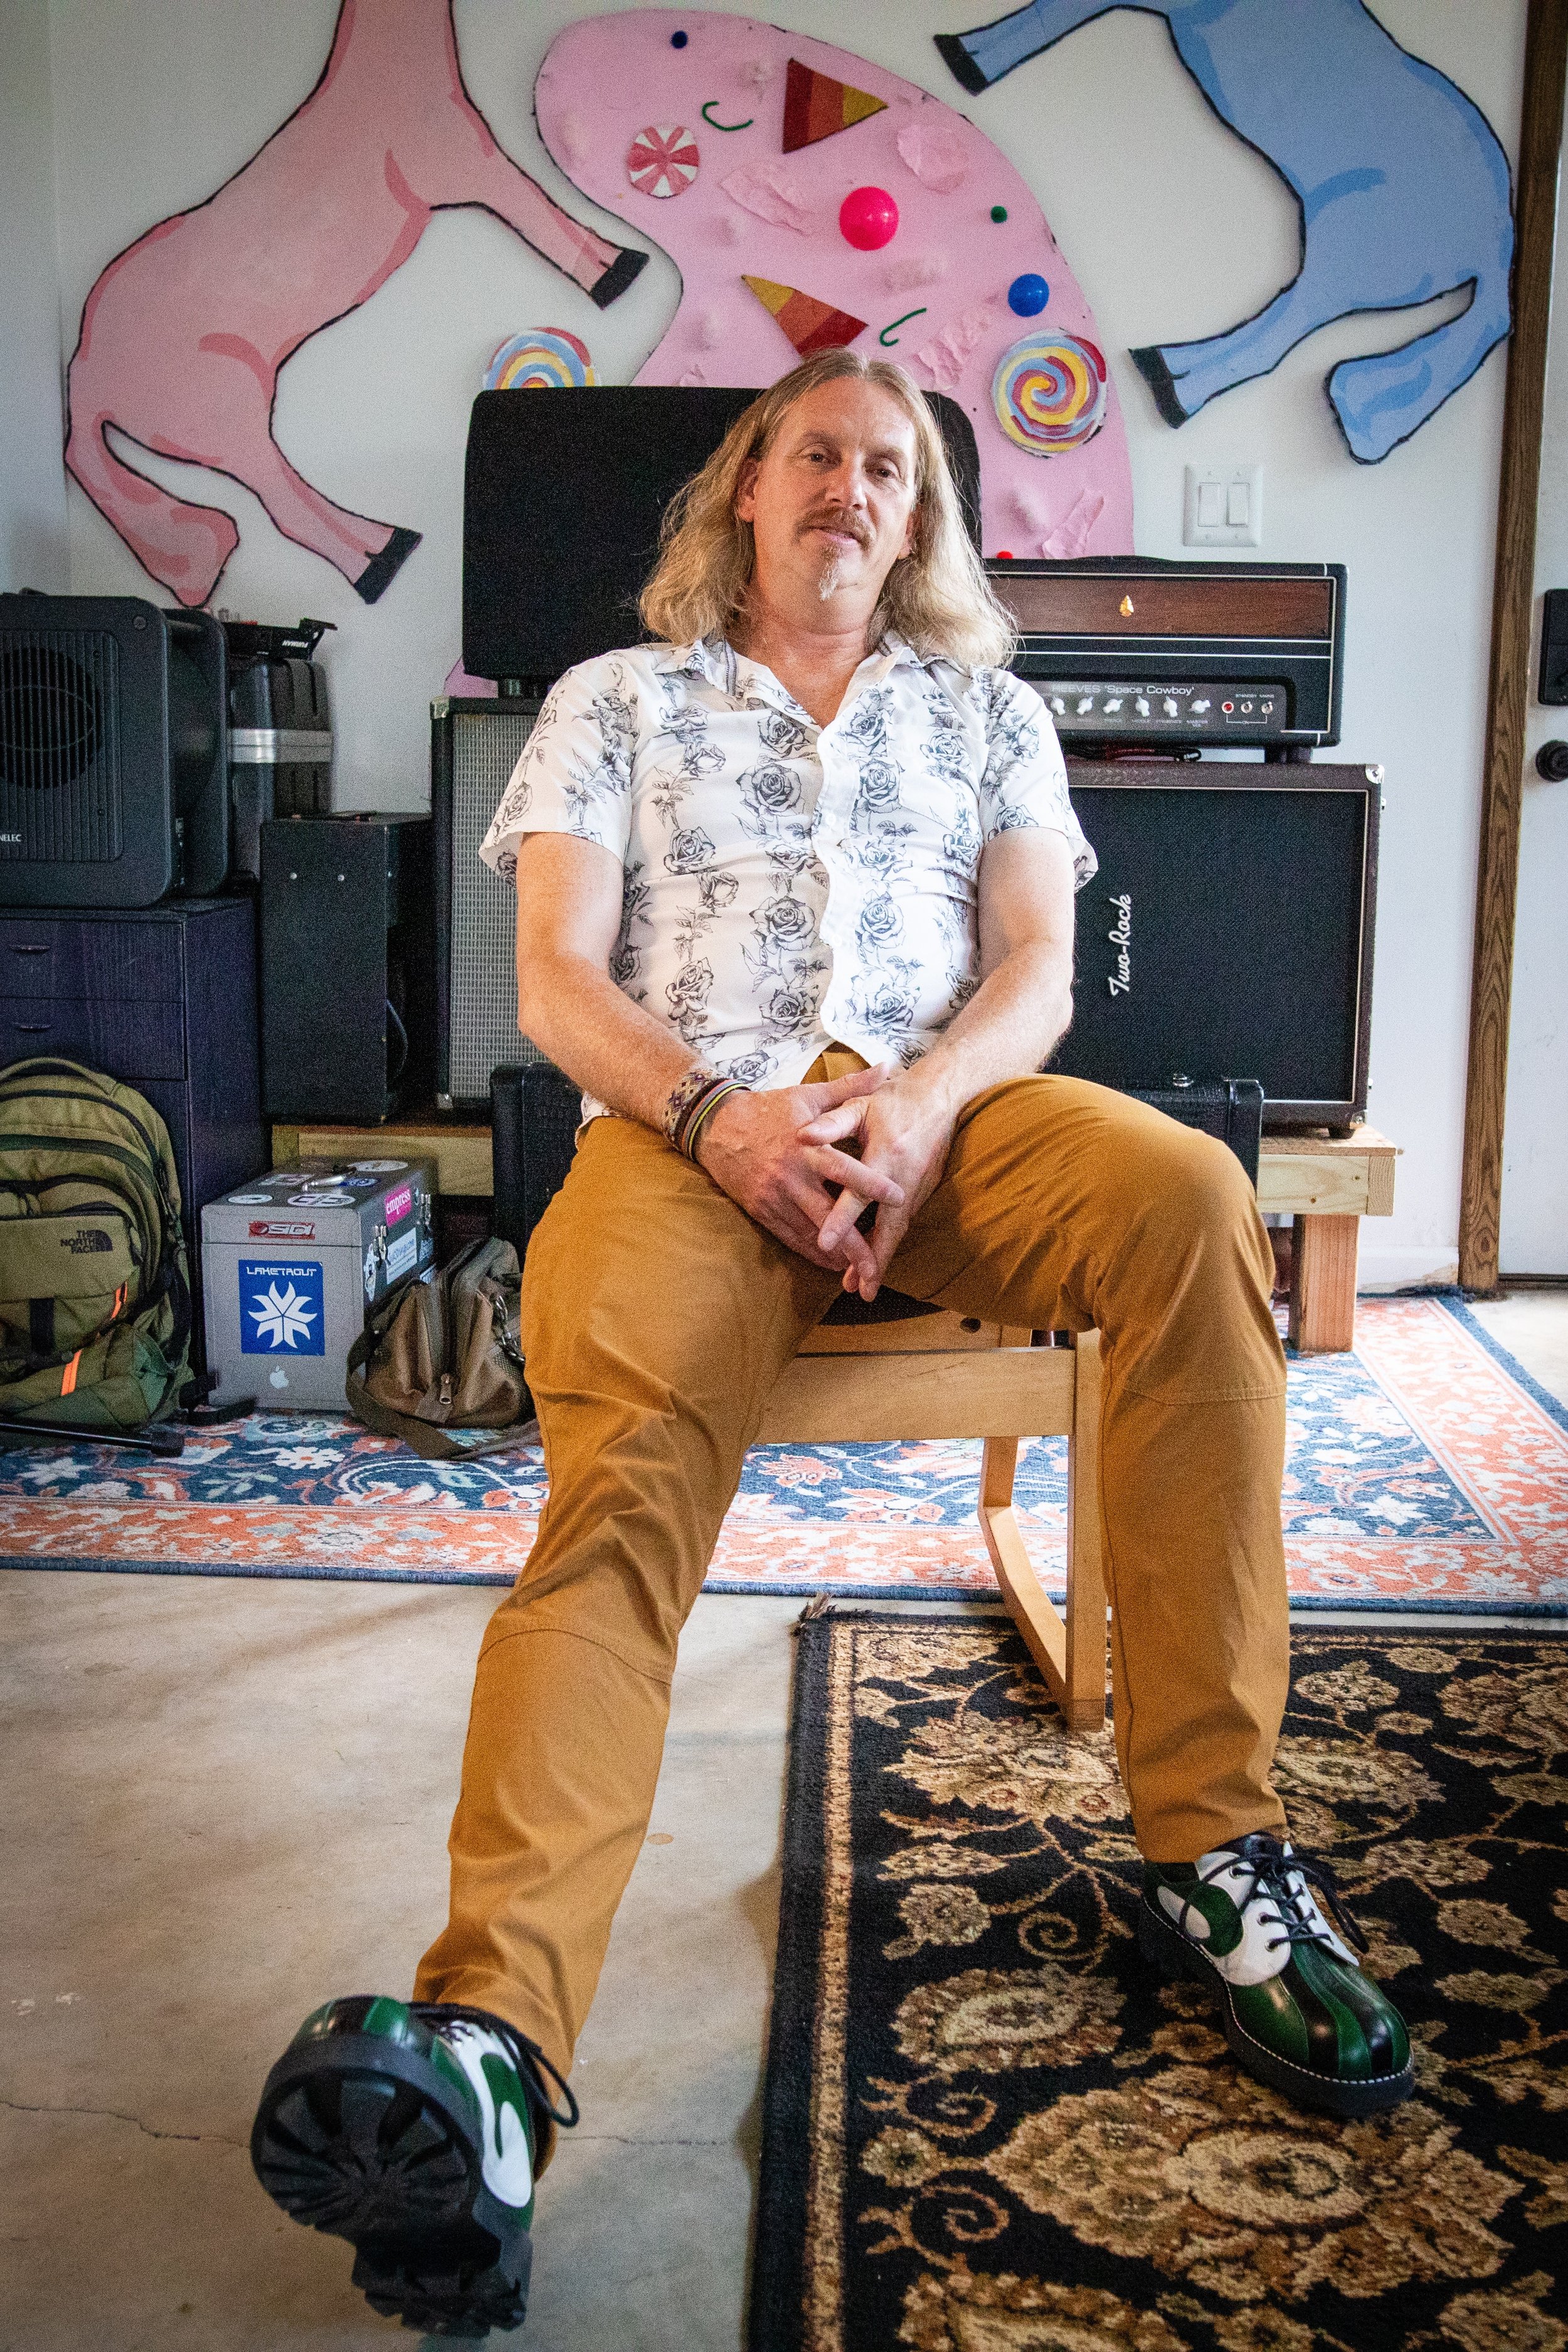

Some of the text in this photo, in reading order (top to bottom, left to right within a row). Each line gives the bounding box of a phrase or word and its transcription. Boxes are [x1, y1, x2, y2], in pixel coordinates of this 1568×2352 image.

[1147, 686, 1194, 696] Cowboy'
[1108, 894, 1131, 996] Two-Rock
[386, 1189, 411, 1215] empress
[60, 1238, 95, 1246] NORTH
[71, 1246, 95, 1254] FACE
